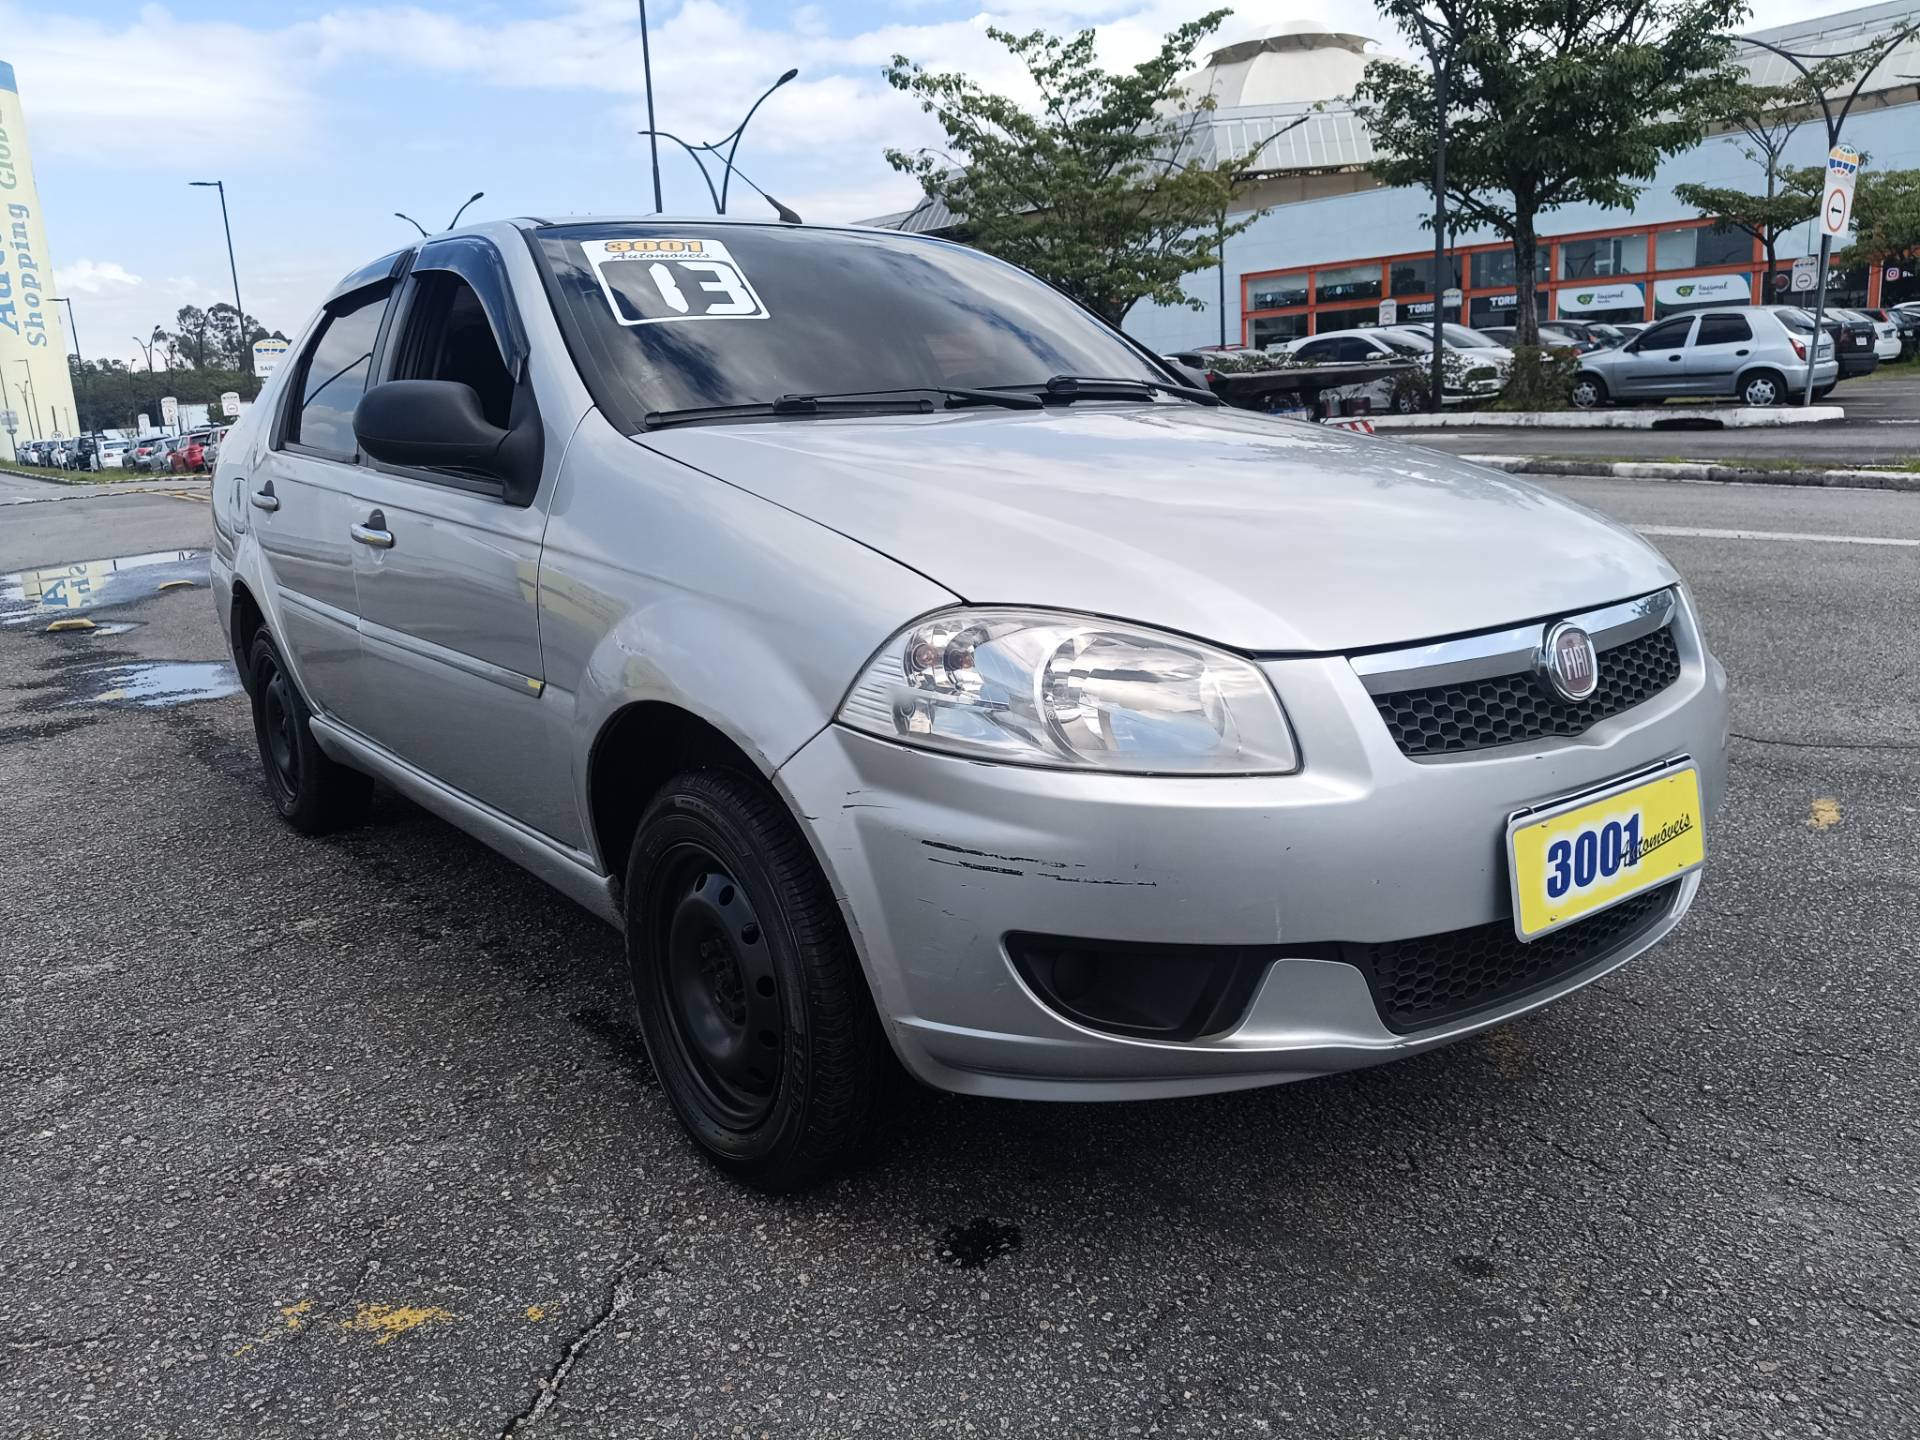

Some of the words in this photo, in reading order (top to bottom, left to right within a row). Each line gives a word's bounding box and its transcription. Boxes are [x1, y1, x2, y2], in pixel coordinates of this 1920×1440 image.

[604, 241, 704, 253] 3001
[8, 203, 48, 347] Shopping
[649, 261, 757, 315] 13
[1561, 644, 1590, 681] FIAT
[1547, 813, 1640, 898] 3001
[1616, 812, 1693, 868] Automóveis
